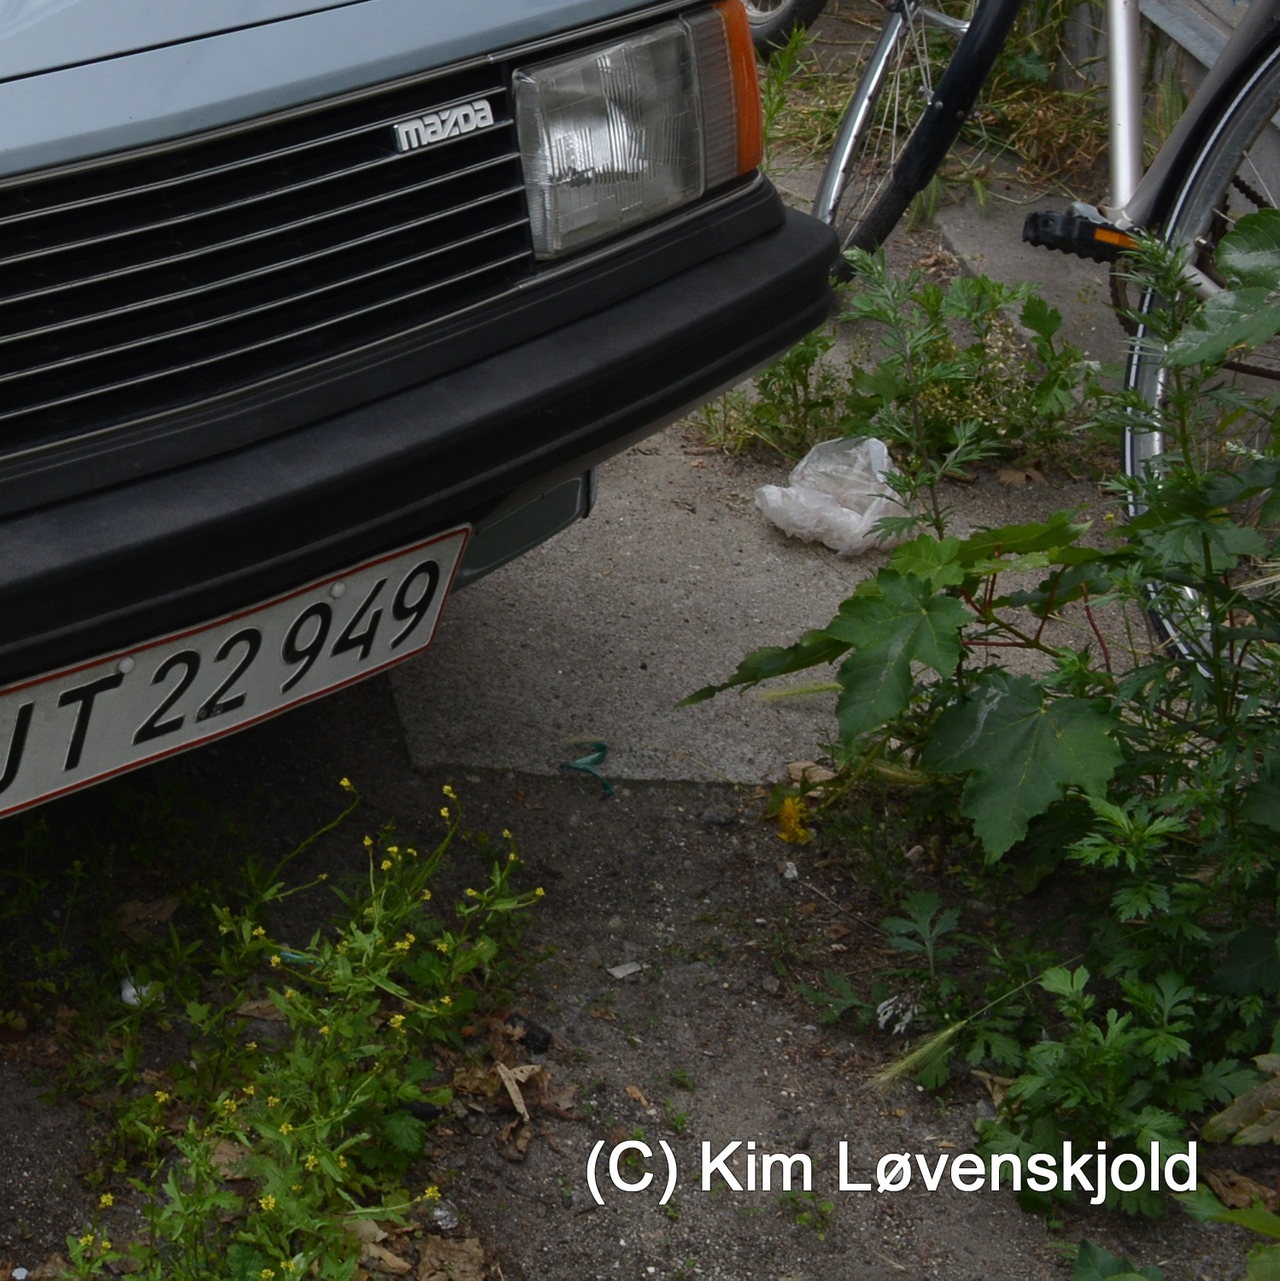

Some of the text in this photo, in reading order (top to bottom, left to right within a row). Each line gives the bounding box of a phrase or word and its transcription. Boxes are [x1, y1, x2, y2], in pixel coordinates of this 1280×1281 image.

[393, 99, 494, 152] mazda
[132, 627, 263, 747] 22
[280, 559, 440, 695] 949
